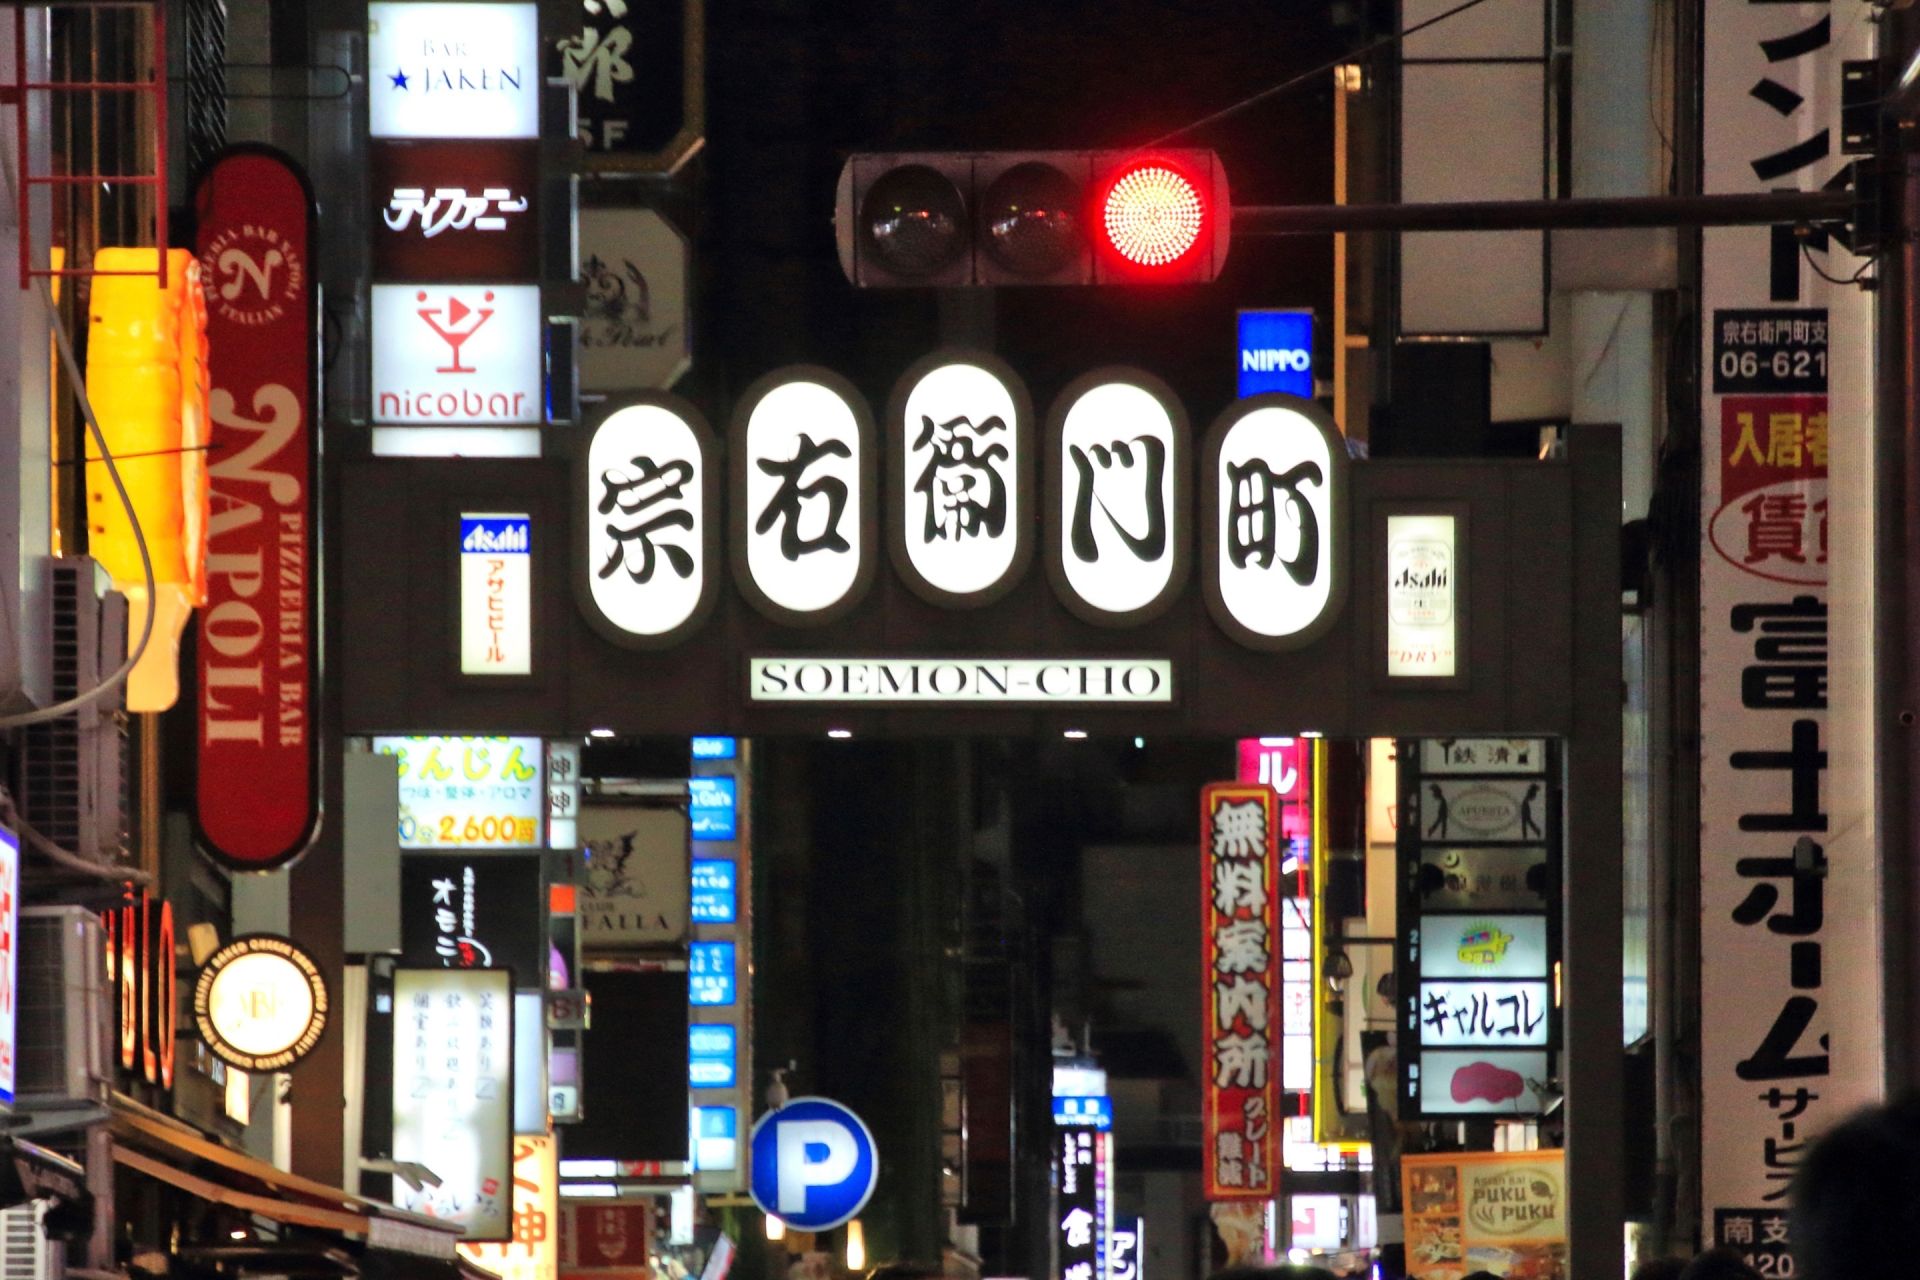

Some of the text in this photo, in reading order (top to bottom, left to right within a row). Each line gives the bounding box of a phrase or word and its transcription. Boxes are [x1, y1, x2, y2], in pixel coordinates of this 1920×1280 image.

[423, 40, 467, 56] BAR
[424, 67, 521, 92] JAKEN
[383, 188, 528, 238] ティファニー
[1242, 349, 1311, 372] NIPPO
[379, 389, 525, 416] nicobar
[598, 412, 1323, 587] 宗右衛門町
[463, 524, 528, 551] Asahi
[1742, 494, 1828, 563] 賃
[206, 383, 301, 748] NAPOLI
[1394, 567, 1448, 588] Asahi
[279, 512, 302, 747] PIZZERIA BAR
[486, 559, 504, 663] アサヒビール
[760, 663, 1161, 697] SOEMON-CHO
[438, 815, 537, 844] 2,600円
[1213, 800, 1268, 1088] 無料案内所
[1423, 989, 1545, 1037] ギャルコレ
[777, 1120, 858, 1213] P
